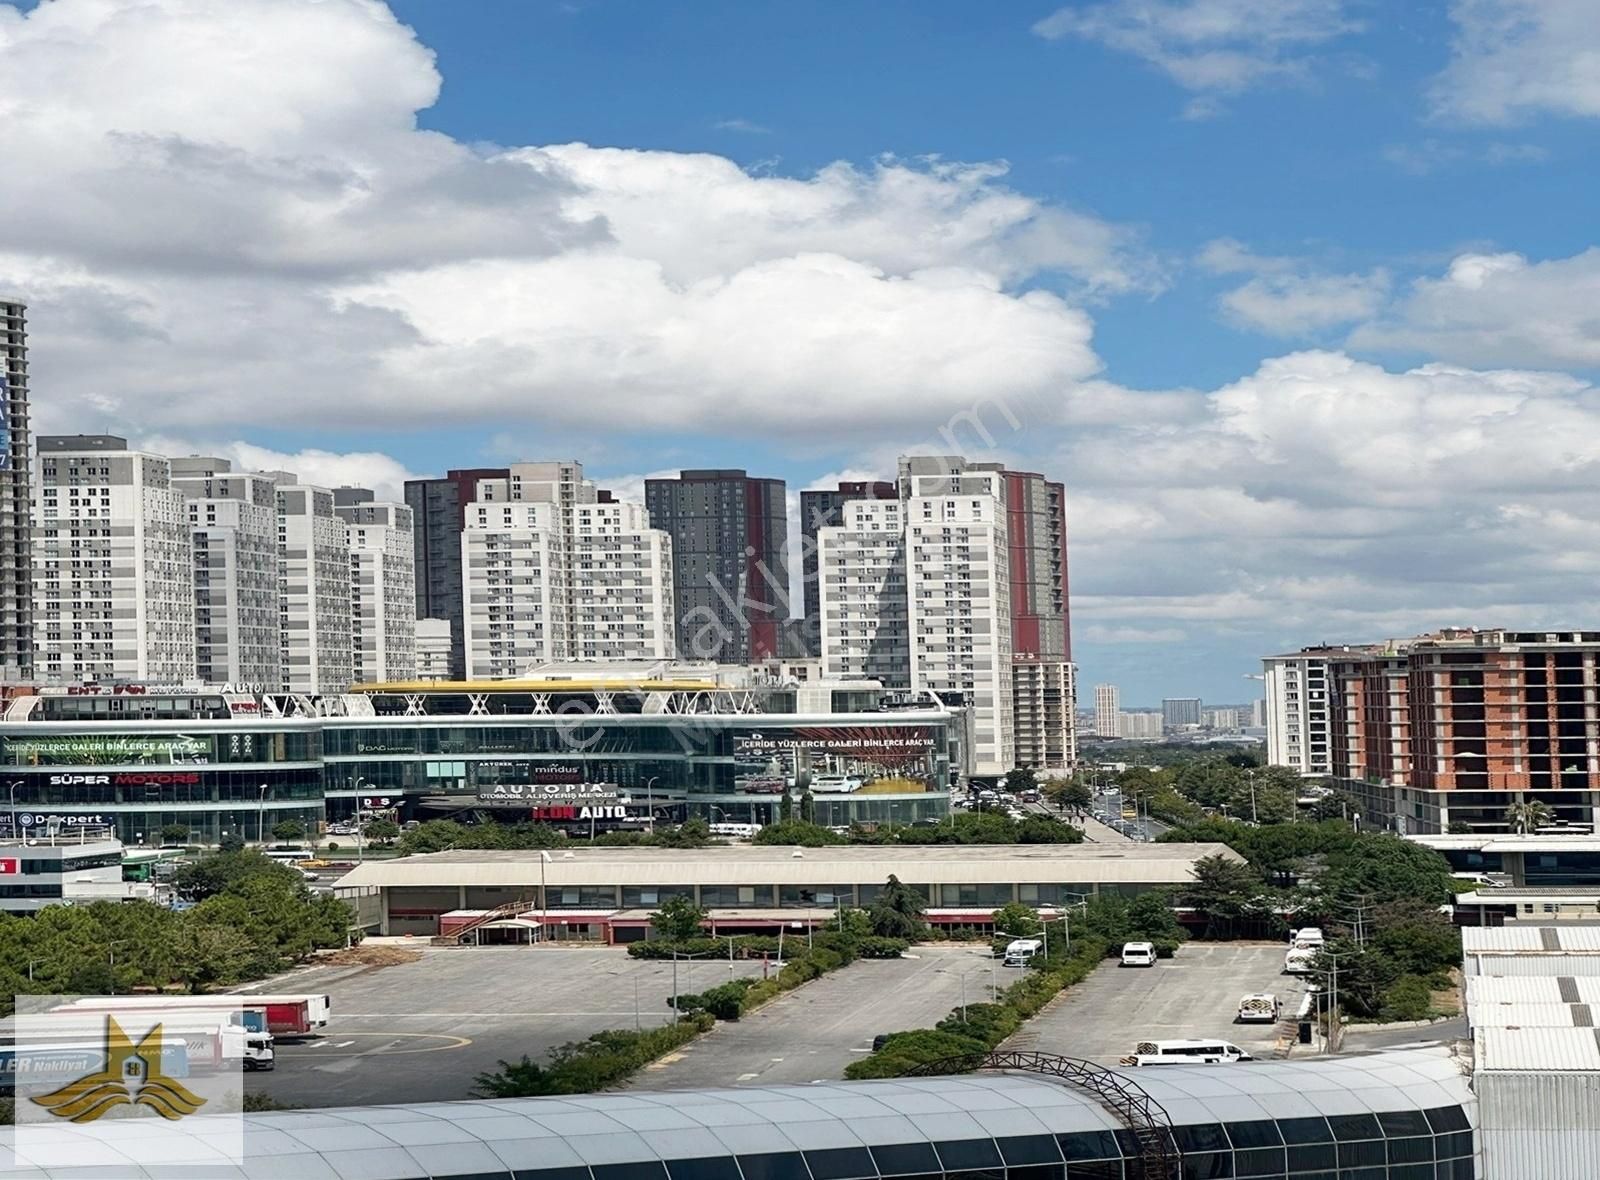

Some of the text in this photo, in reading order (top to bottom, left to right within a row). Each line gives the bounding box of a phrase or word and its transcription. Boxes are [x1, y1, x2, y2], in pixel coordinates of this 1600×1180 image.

[777, 739, 826, 748] YÜZLERCE
[827, 738, 862, 748] GALERİ
[863, 738, 904, 747] BİNLERCE
[50, 774, 200, 785] SÜPER MOTORS
[494, 784, 603, 794] AUTOPIA
[580, 806, 626, 818] AUTO
[35, 814, 102, 826] D-xpert
